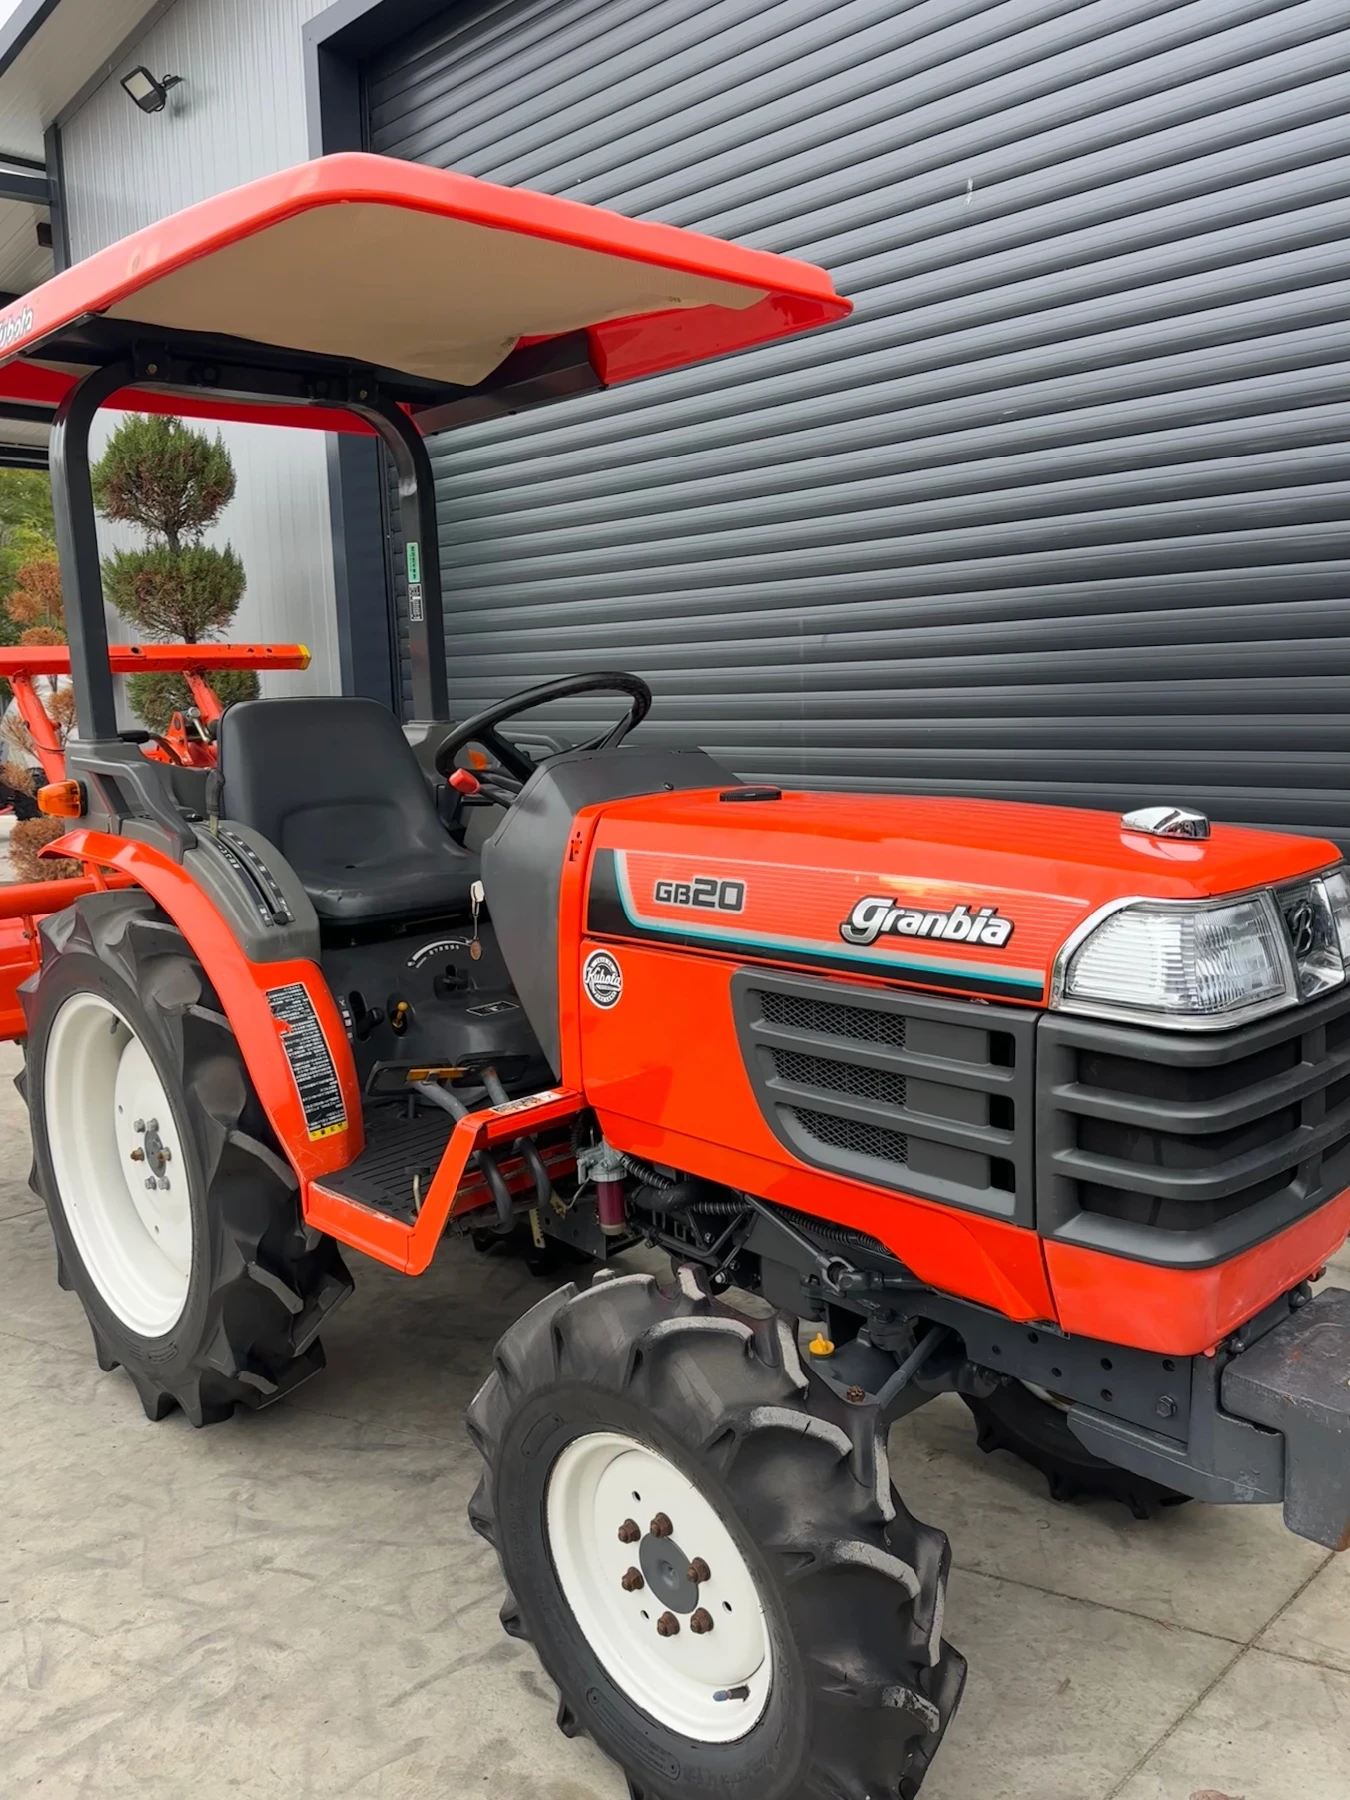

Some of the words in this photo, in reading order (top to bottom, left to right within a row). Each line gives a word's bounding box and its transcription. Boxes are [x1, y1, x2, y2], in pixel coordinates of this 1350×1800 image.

[0, 305, 33, 348] ubota
[655, 878, 745, 911] GB20
[840, 896, 1013, 946] Granbia
[585, 966, 621, 993] Kubota
